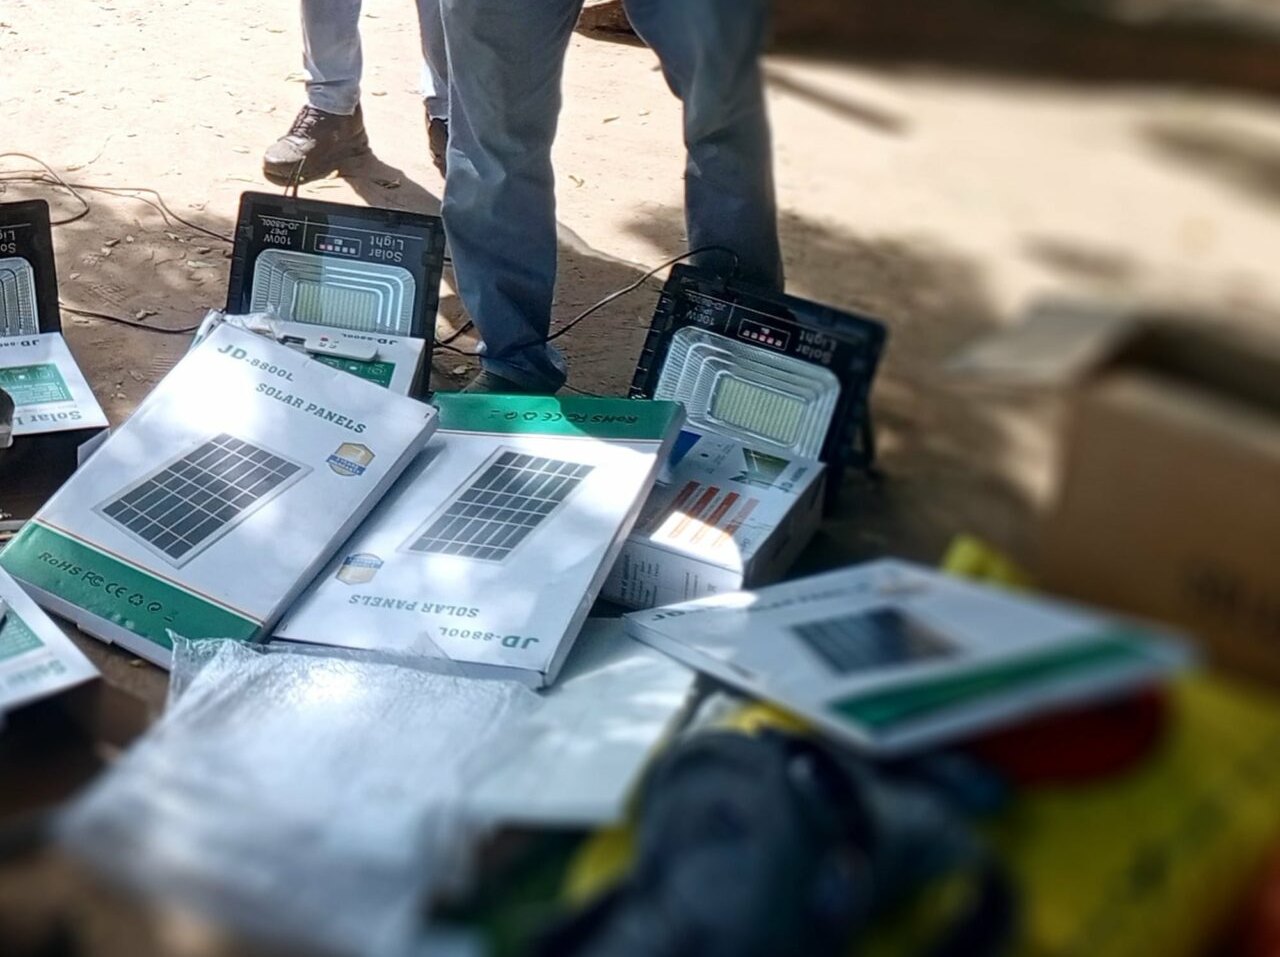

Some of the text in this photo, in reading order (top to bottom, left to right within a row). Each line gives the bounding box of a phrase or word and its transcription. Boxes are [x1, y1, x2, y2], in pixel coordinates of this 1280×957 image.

[263, 235, 292, 245] 100W
[370, 235, 404, 250] Light
[369, 249, 404, 263] Solar
[798, 329, 838, 352] Light
[217, 343, 295, 383] JD-8800L
[795, 345, 834, 365] Solar
[30, 409, 82, 424] Solar
[256, 382, 367, 434] SOLAR PANELS
[38, 551, 83, 576] RoHS
[348, 594, 480, 619] SOLAR PANELS
[439, 626, 540, 650] JD-8800L
